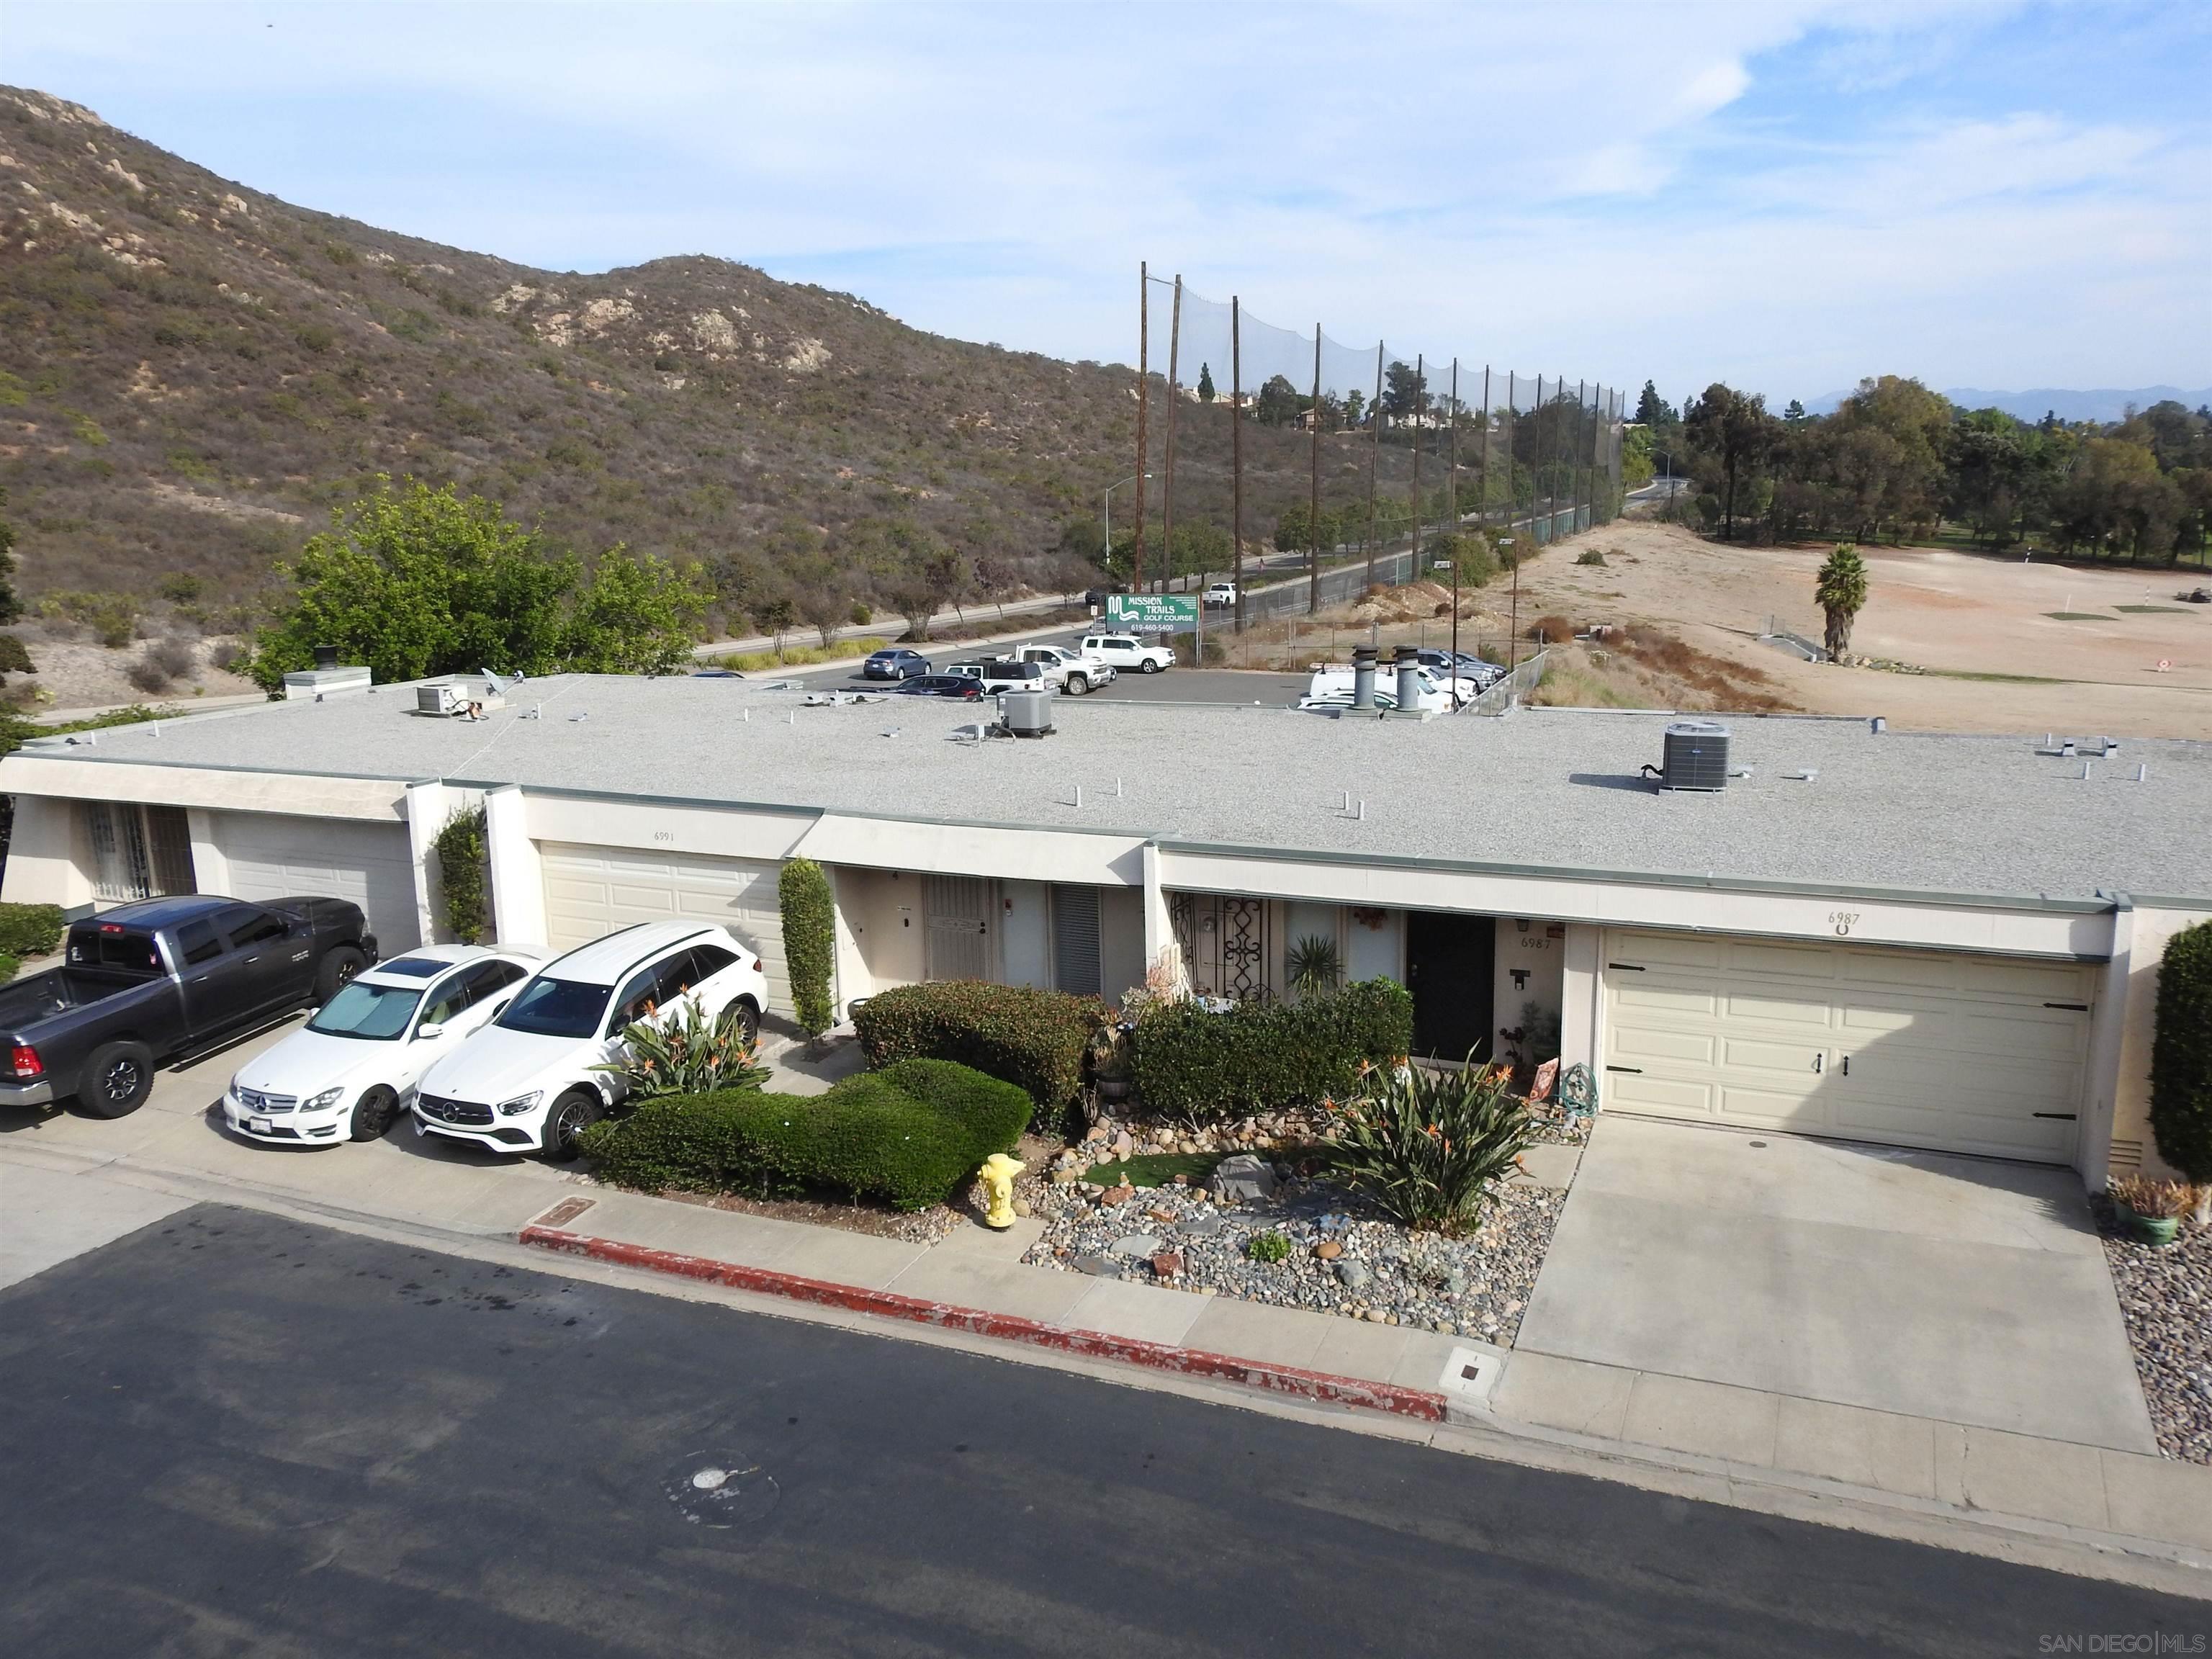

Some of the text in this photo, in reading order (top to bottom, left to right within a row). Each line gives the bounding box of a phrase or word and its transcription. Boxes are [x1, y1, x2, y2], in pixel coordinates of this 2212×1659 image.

[1128, 596, 1162, 606] MISSION
[1146, 606, 1175, 614] TRAILS
[654, 832, 674, 842] 6991
[1828, 912, 1861, 925] 6987
[1521, 938, 1550, 949] 6987
